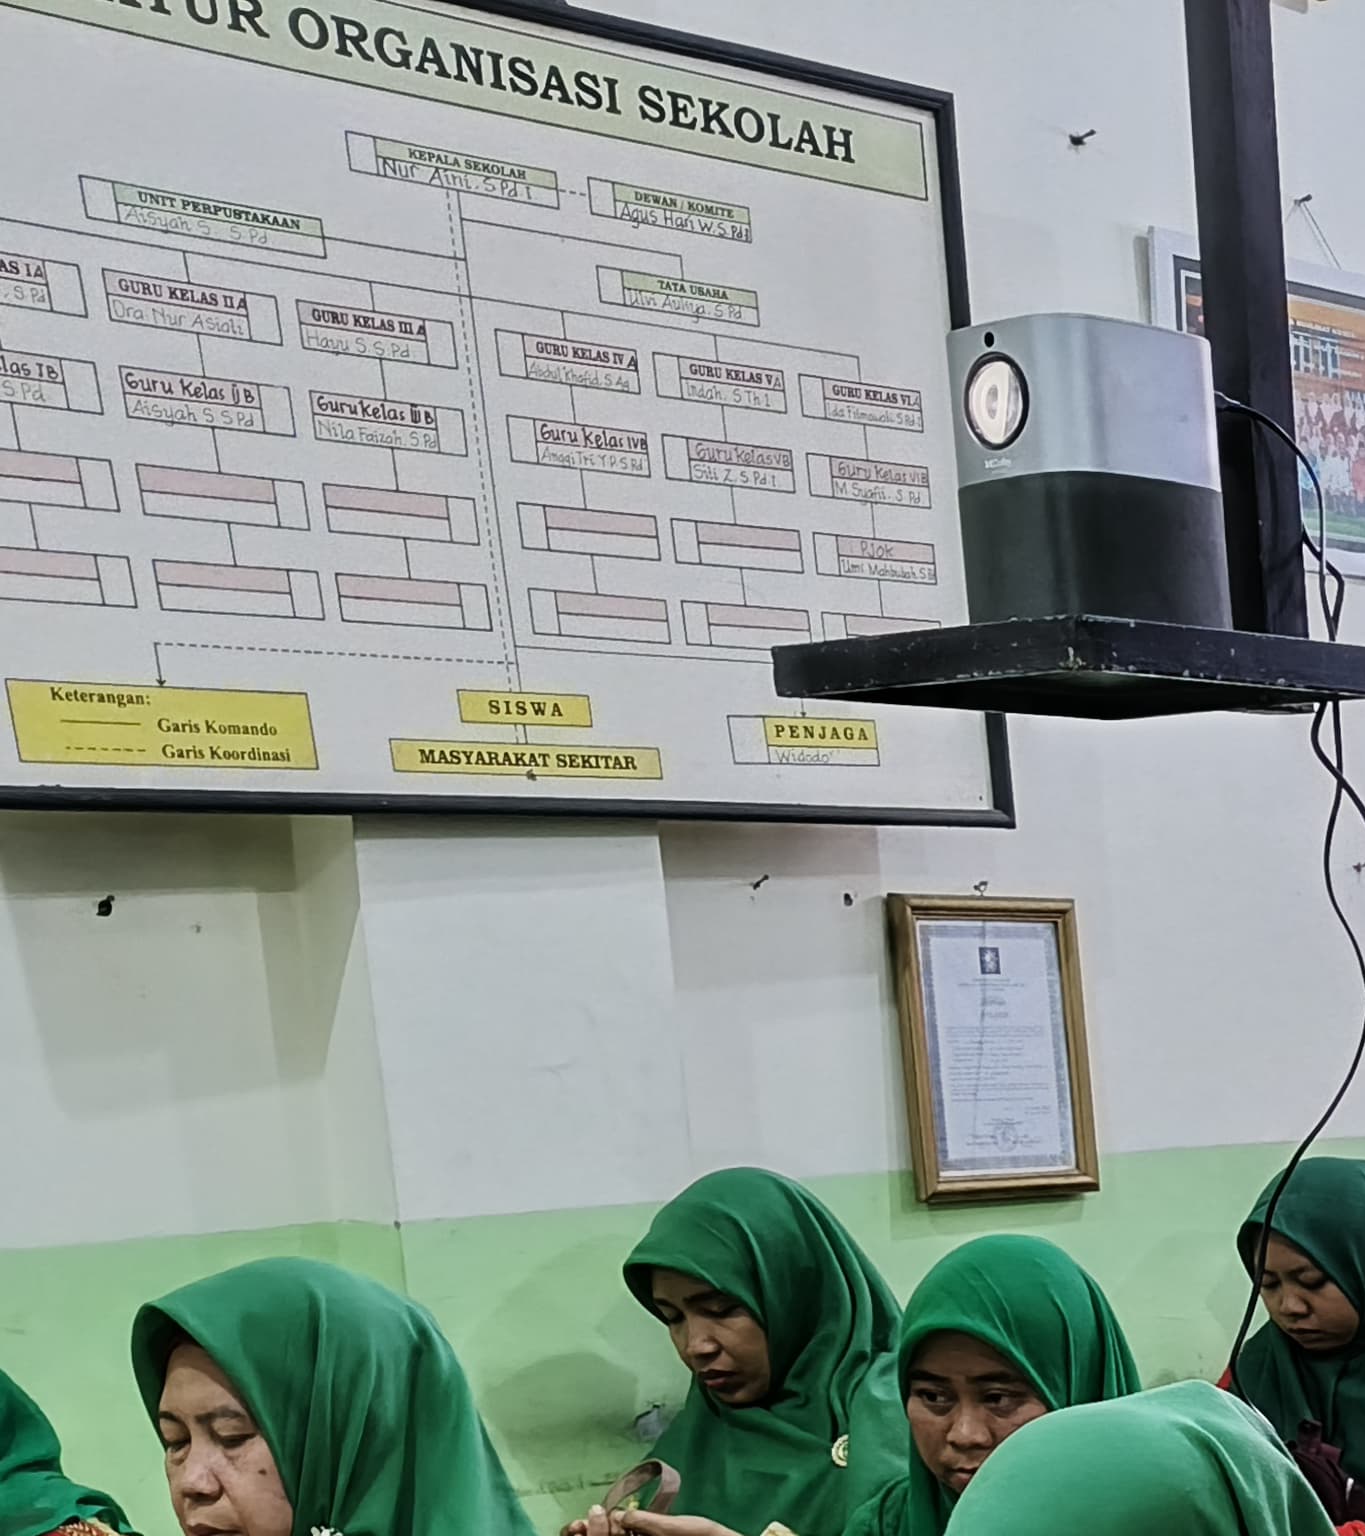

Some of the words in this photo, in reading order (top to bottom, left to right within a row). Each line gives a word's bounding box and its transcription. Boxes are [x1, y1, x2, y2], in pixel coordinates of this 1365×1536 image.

[288, 7, 622, 115] ORGANISASI
[638, 85, 855, 164] SEKOLAH
[382, 158, 420, 179] Nur
[408, 148, 461, 168] KEPALA
[464, 159, 526, 180] SEKOLAH
[138, 191, 176, 208] UNIT
[181, 199, 301, 230] PERPUSTAKAAN
[620, 203, 658, 229] Agus
[634, 191, 677, 209] DEWAN
[688, 200, 735, 219] KOMITE
[118, 278, 163, 298] GURU
[167, 286, 219, 307] KELAS
[657, 280, 687, 293] TATA
[690, 286, 728, 300] USAHA
[151, 307, 185, 326] Nur
[312, 308, 349, 325] GURU
[353, 314, 396, 332] KELAS
[536, 341, 568, 358] GURU
[572, 347, 610, 363] KELAS
[125, 372, 173, 395] Guru
[689, 363, 722, 378] GURU
[725, 368, 763, 384] KELAS
[832, 384, 861, 399] GURU
[864, 389, 898, 404] KELAS
[541, 423, 578, 443] Guru
[50, 686, 151, 709] Keterangan:
[488, 700, 564, 718] SISWA
[157, 718, 201, 734] Garis
[204, 719, 278, 737] Komando
[774, 724, 869, 741] PENJAGA
[161, 743, 205, 761] Garis
[209, 745, 292, 763] Koordinasi
[418, 748, 551, 768] MASYARAKAT
[556, 752, 638, 771] SEKITAR
